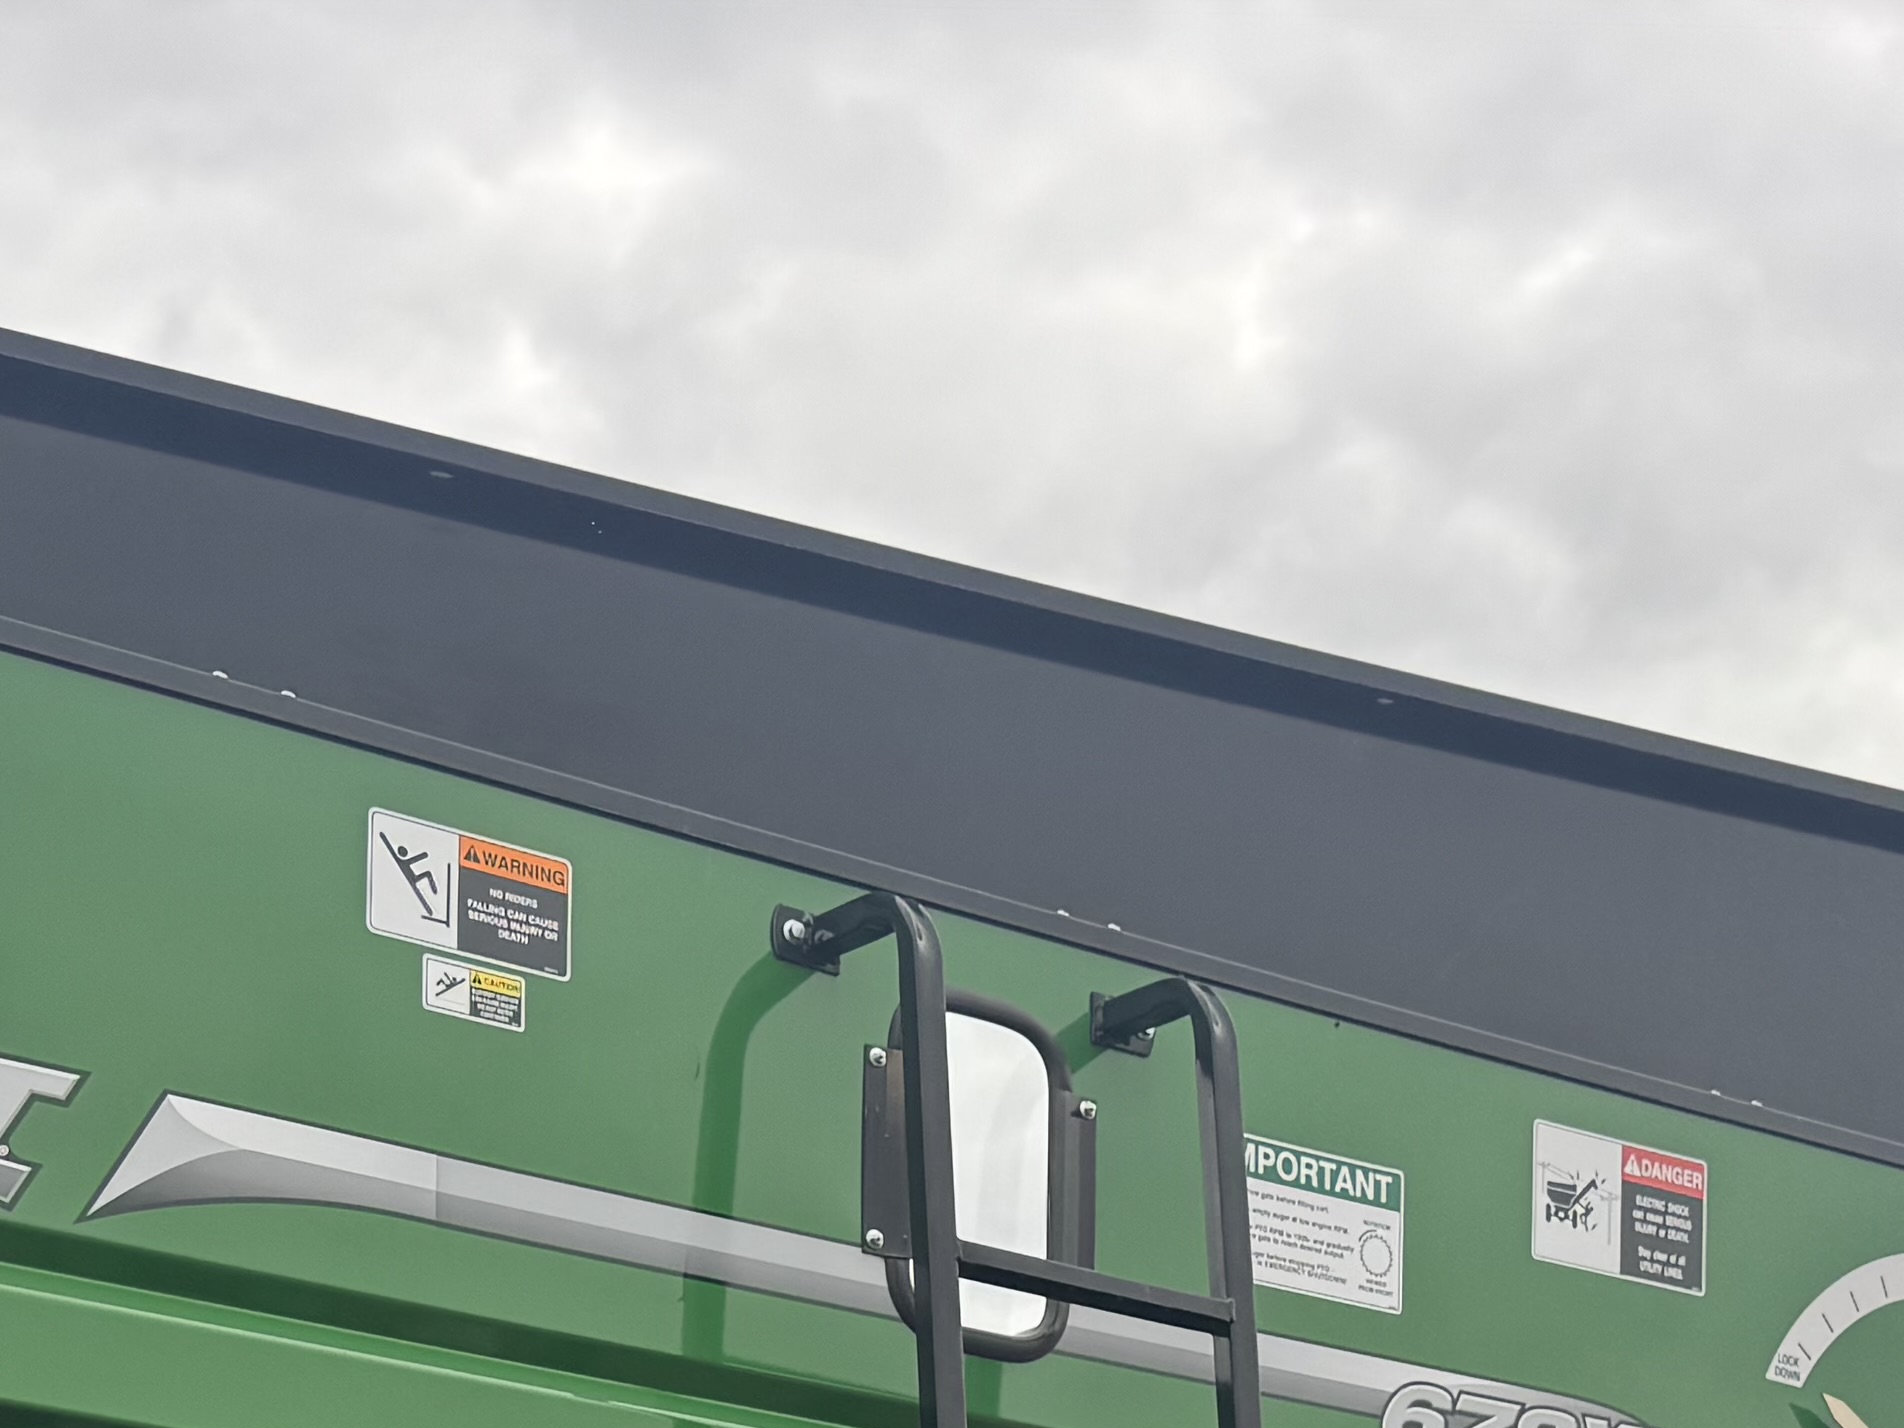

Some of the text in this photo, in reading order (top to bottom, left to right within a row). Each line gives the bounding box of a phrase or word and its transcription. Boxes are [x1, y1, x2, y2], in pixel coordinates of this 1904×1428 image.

[482, 850, 565, 887] WARNING
[490, 888, 537, 908] NO RIDERS
[468, 898, 558, 931] FALLING CAN CAUSE
[468, 910, 508, 928] SERIOUS
[544, 930, 557, 941] OR
[485, 978, 518, 993] CAUTION
[1245, 1143, 1392, 1203] MPORTANT
[1642, 1159, 1703, 1190] DANGER
[1774, 1366, 1801, 1382] DOWN
[1777, 1353, 1800, 1367] LOCK
